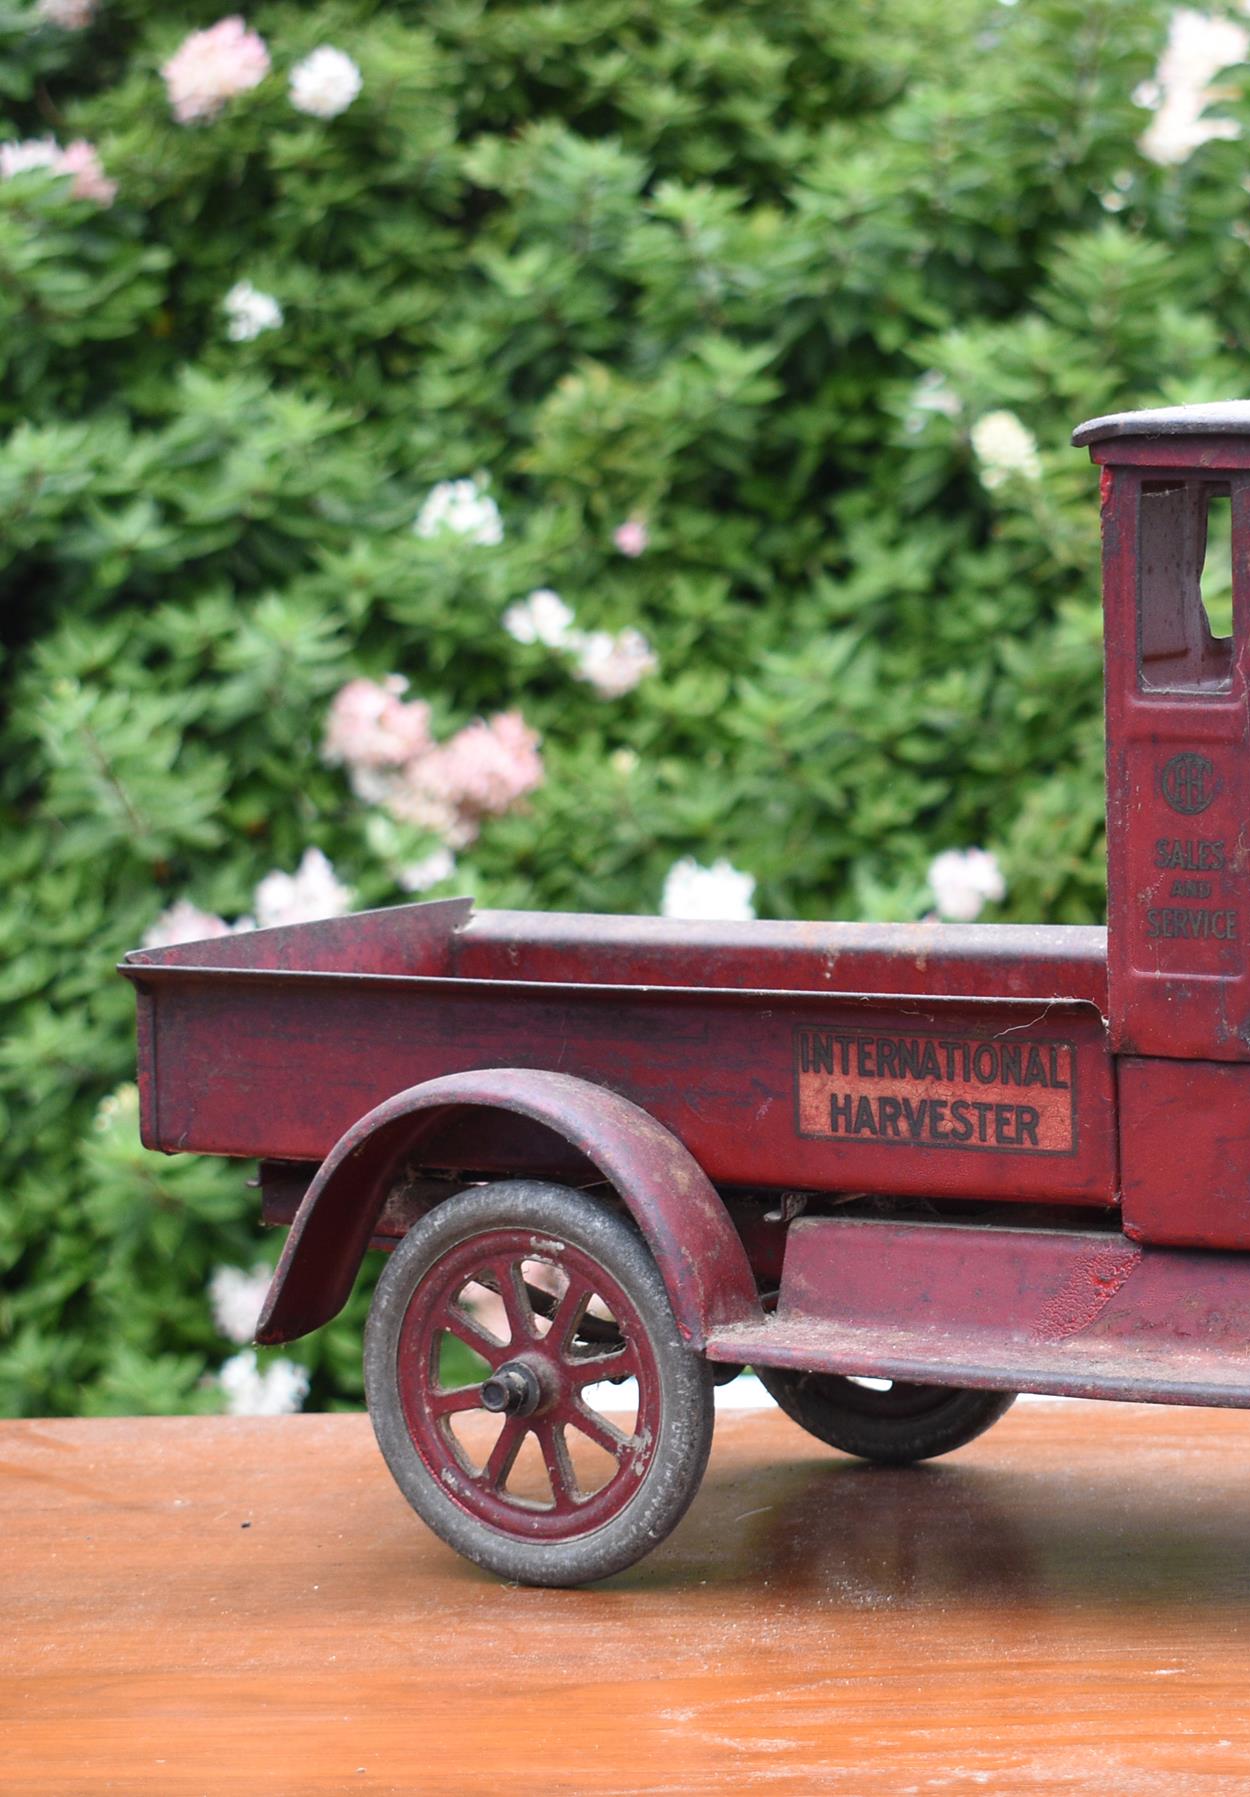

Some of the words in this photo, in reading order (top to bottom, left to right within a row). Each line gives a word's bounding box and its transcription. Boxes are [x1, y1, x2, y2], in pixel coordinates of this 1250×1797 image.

[1155, 838, 1226, 871] SALES
[1171, 879, 1212, 899] AND
[1147, 907, 1238, 940] SERVICE
[800, 1032, 1070, 1090] INTERNATIONAL
[830, 1093, 1040, 1146] HARVESTER
